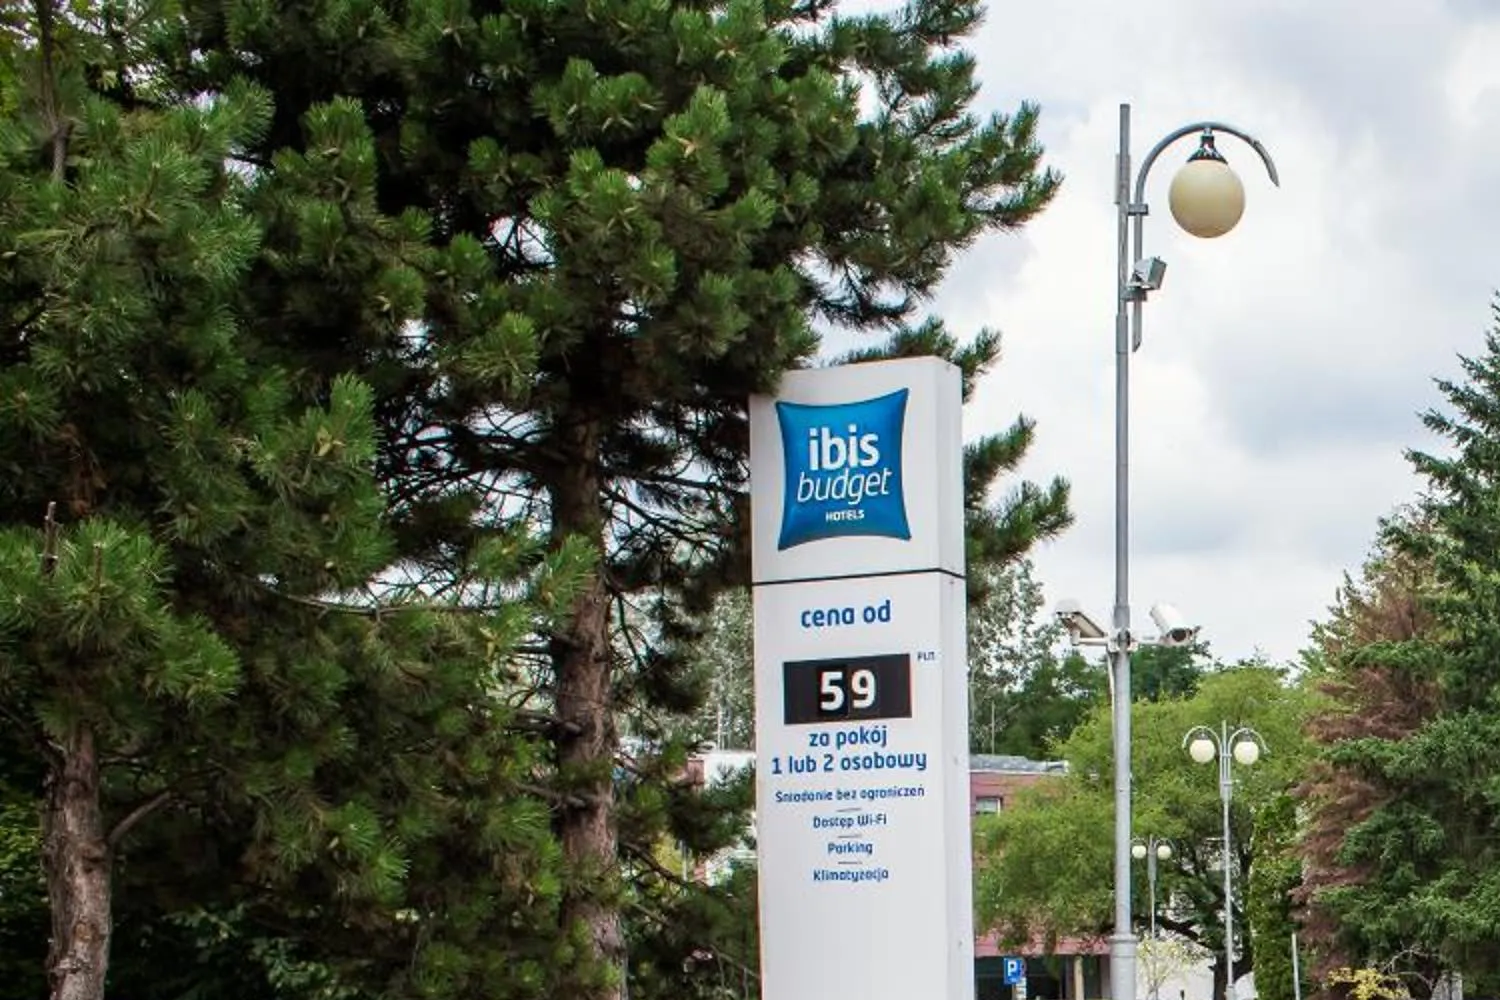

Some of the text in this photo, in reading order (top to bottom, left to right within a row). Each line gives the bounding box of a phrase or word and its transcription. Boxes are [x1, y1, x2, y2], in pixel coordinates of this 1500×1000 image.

[809, 424, 879, 471] ibis
[797, 467, 892, 505] budget
[826, 509, 864, 522] HOTELS
[801, 600, 891, 628] cena od
[820, 669, 876, 711] 59
[809, 725, 887, 750] za pokój
[772, 751, 927, 774] 1 lub 2 osobowy
[836, 789, 857, 800] bez
[860, 784, 925, 800] ograniczeń
[813, 813, 887, 829] Dostęp Wi-Fi
[827, 842, 873, 855] Parking
[813, 868, 889, 882] Klimatyzacja
[1008, 960, 1017, 976] P
